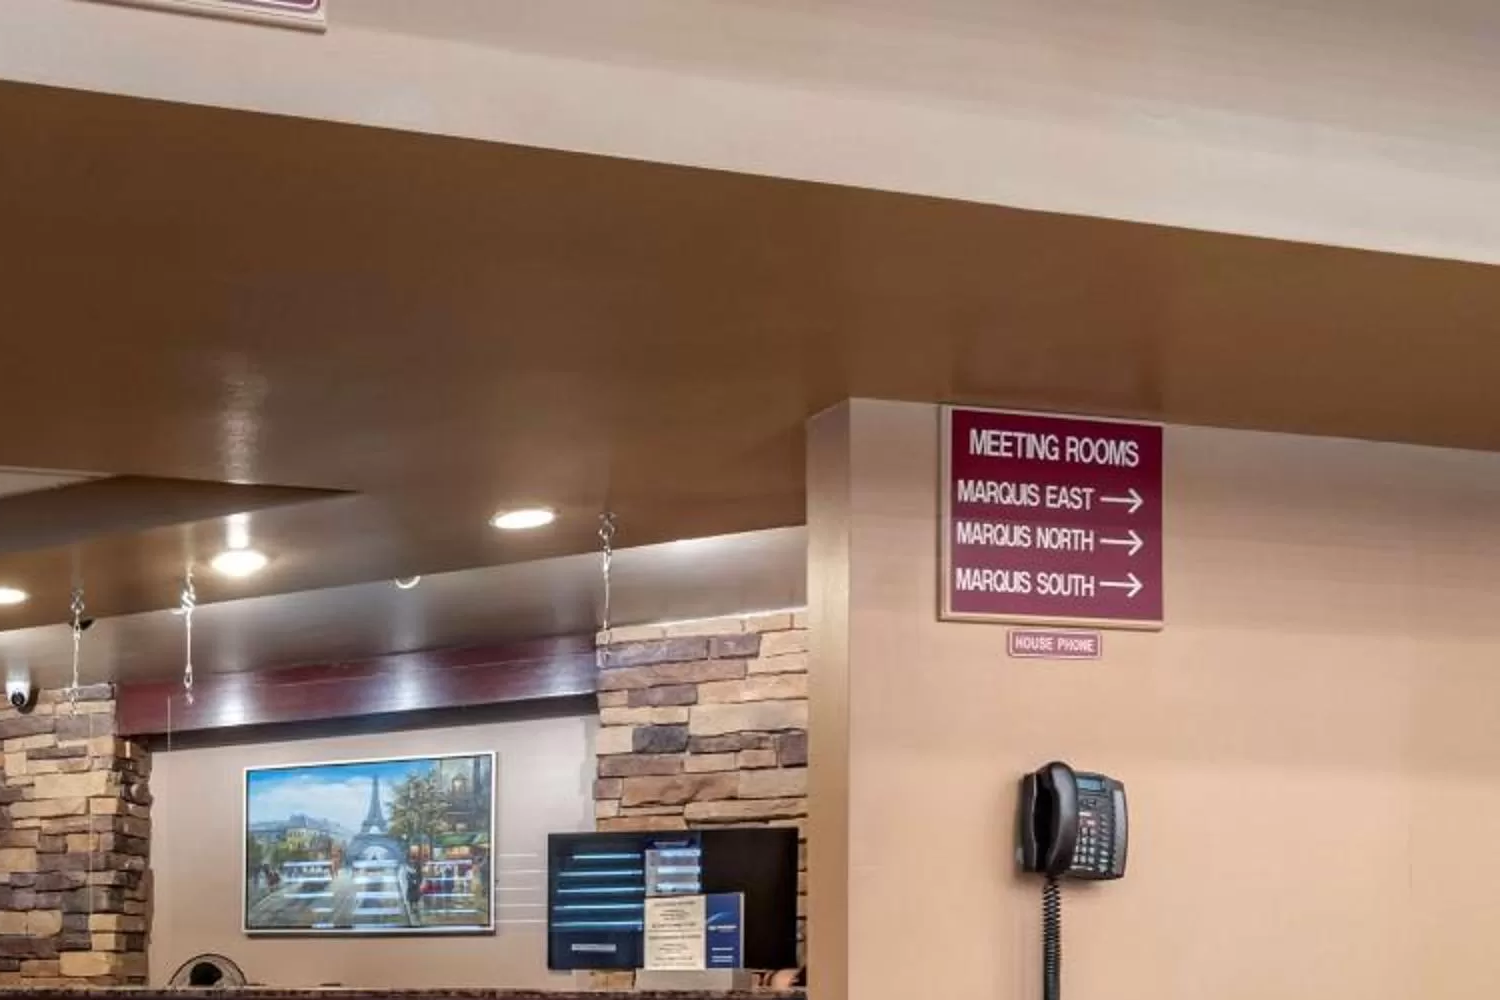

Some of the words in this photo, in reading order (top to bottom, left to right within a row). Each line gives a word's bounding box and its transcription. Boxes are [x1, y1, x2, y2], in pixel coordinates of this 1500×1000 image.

[969, 428, 1060, 462] MEETING
[1065, 436, 1140, 467] ROOMS
[957, 479, 1040, 507] MARQUIS
[1045, 486, 1095, 511] EAST
[957, 521, 1031, 548] MARQUIS
[1036, 527, 1094, 552] NORTH
[956, 567, 1031, 593] MARQUIS
[1036, 572, 1095, 597] SOUTH
[1015, 635, 1054, 651] HOUSE
[1057, 637, 1097, 653] PHONE
